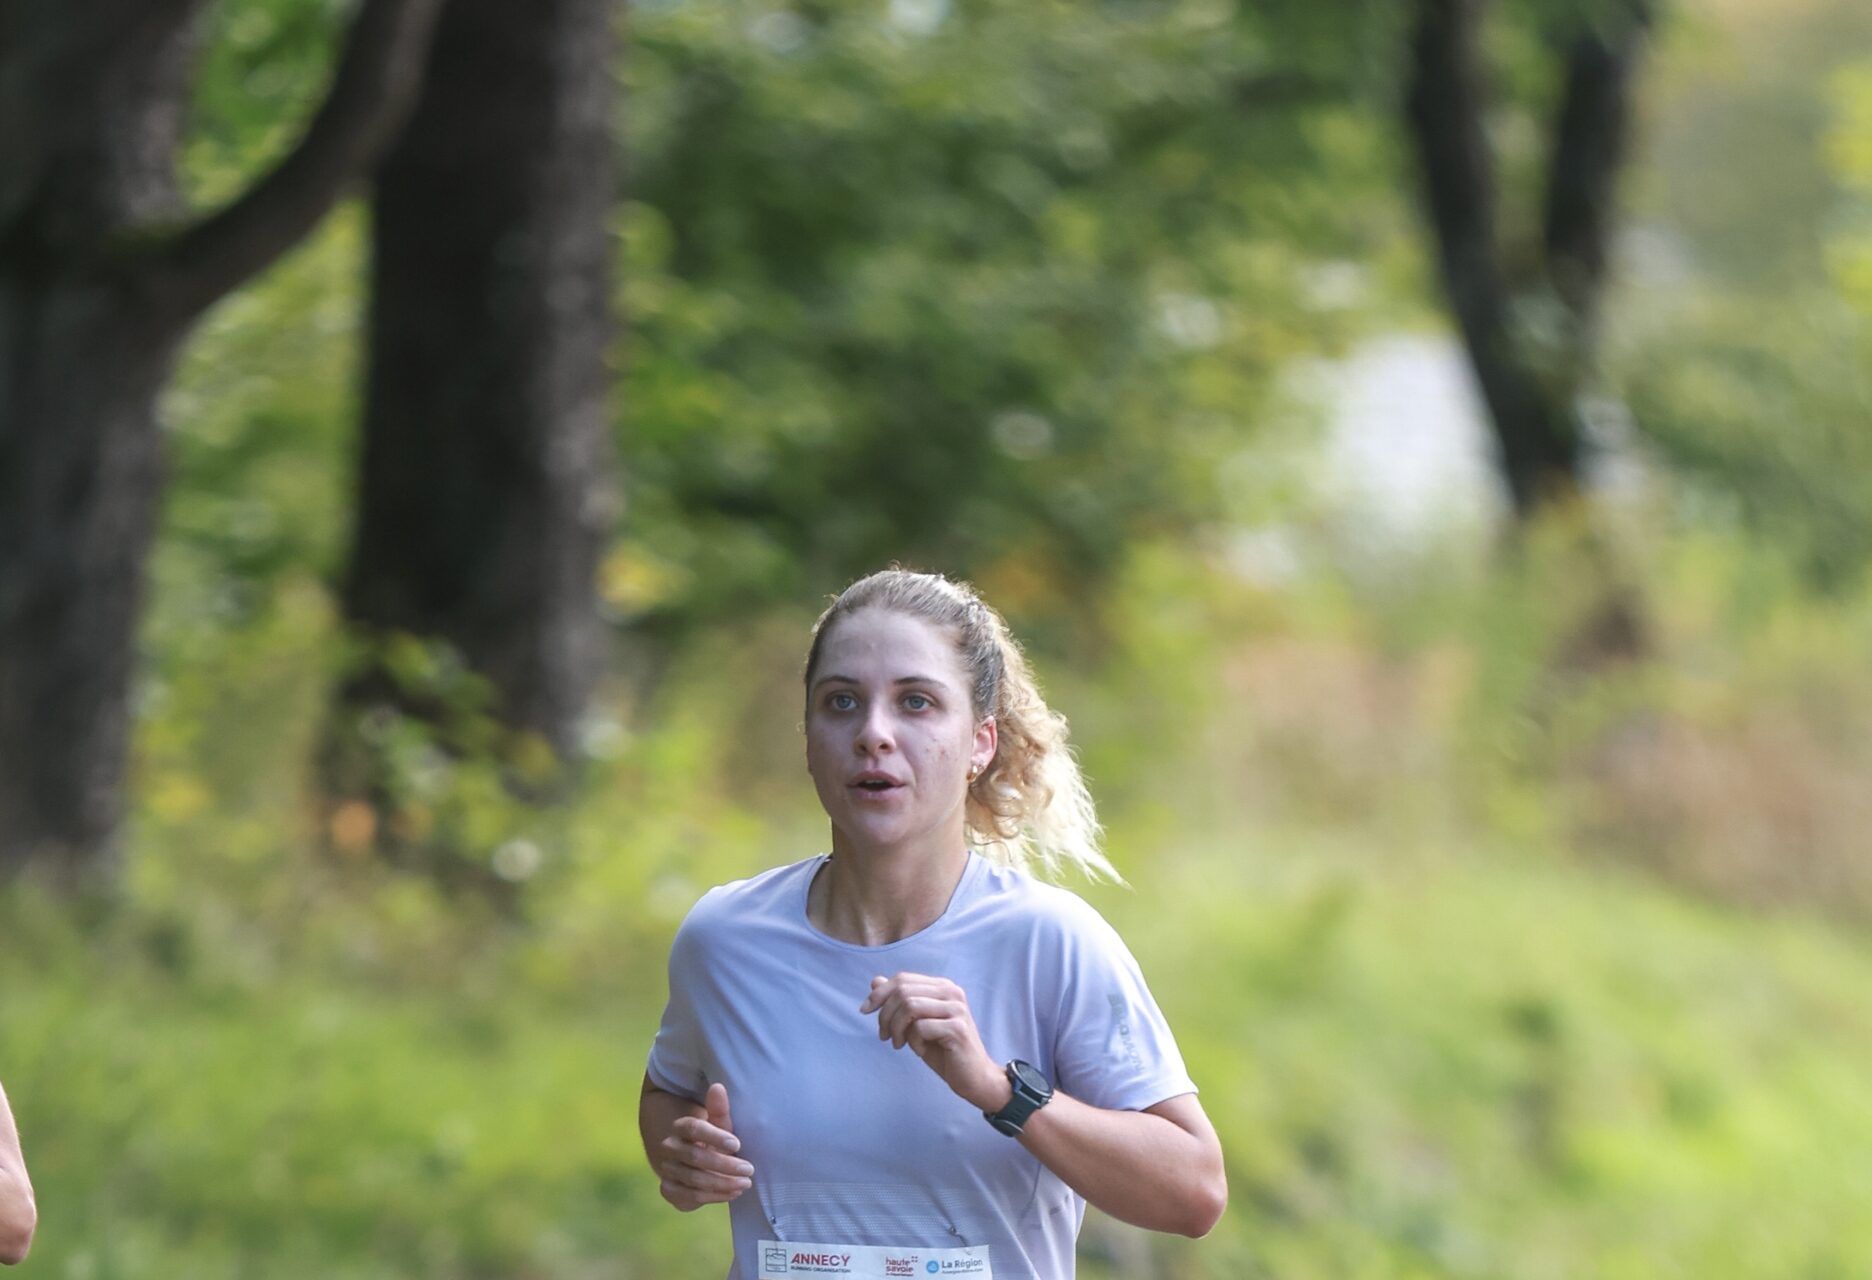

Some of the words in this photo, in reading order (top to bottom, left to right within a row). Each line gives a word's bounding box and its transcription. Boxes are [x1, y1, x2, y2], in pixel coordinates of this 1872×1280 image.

[791, 1253, 851, 1266] ANNECY
[886, 1256, 910, 1267] haute
[941, 1259, 953, 1269] La
[954, 1257, 983, 1269] Région
